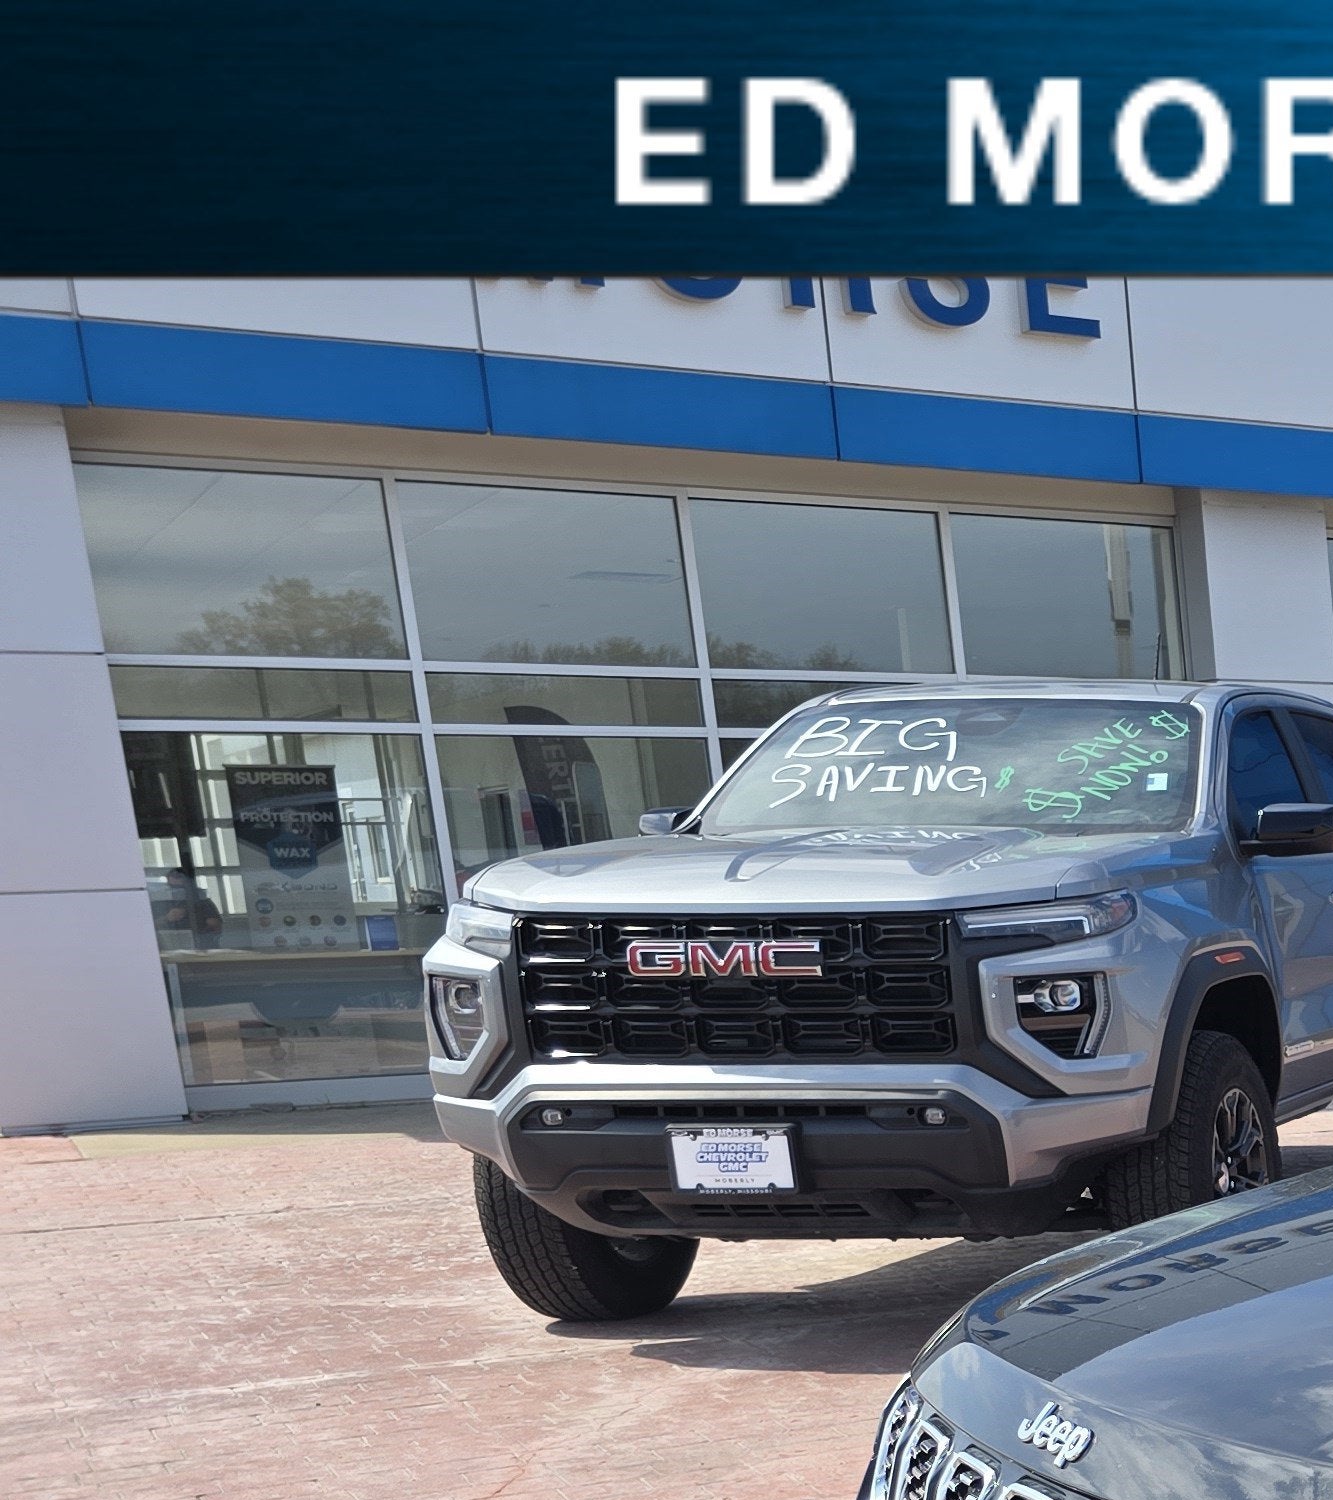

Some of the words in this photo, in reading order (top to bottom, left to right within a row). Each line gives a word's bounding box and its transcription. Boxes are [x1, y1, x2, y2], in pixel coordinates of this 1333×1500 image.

[784, 716, 957, 761] BIG
[1057, 717, 1143, 775] SAVE
[235, 772, 328, 786] SUPERIOR
[240, 811, 334, 823] PROTECTION
[275, 847, 311, 858] WAX
[626, 939, 822, 977] GMC
[702, 1143, 717, 1152] ED
[718, 1143, 762, 1152] MORSE
[696, 1152, 768, 1162] CHEVROLET
[719, 1162, 748, 1171] GMC
[1018, 1401, 1093, 1468] Jeep
